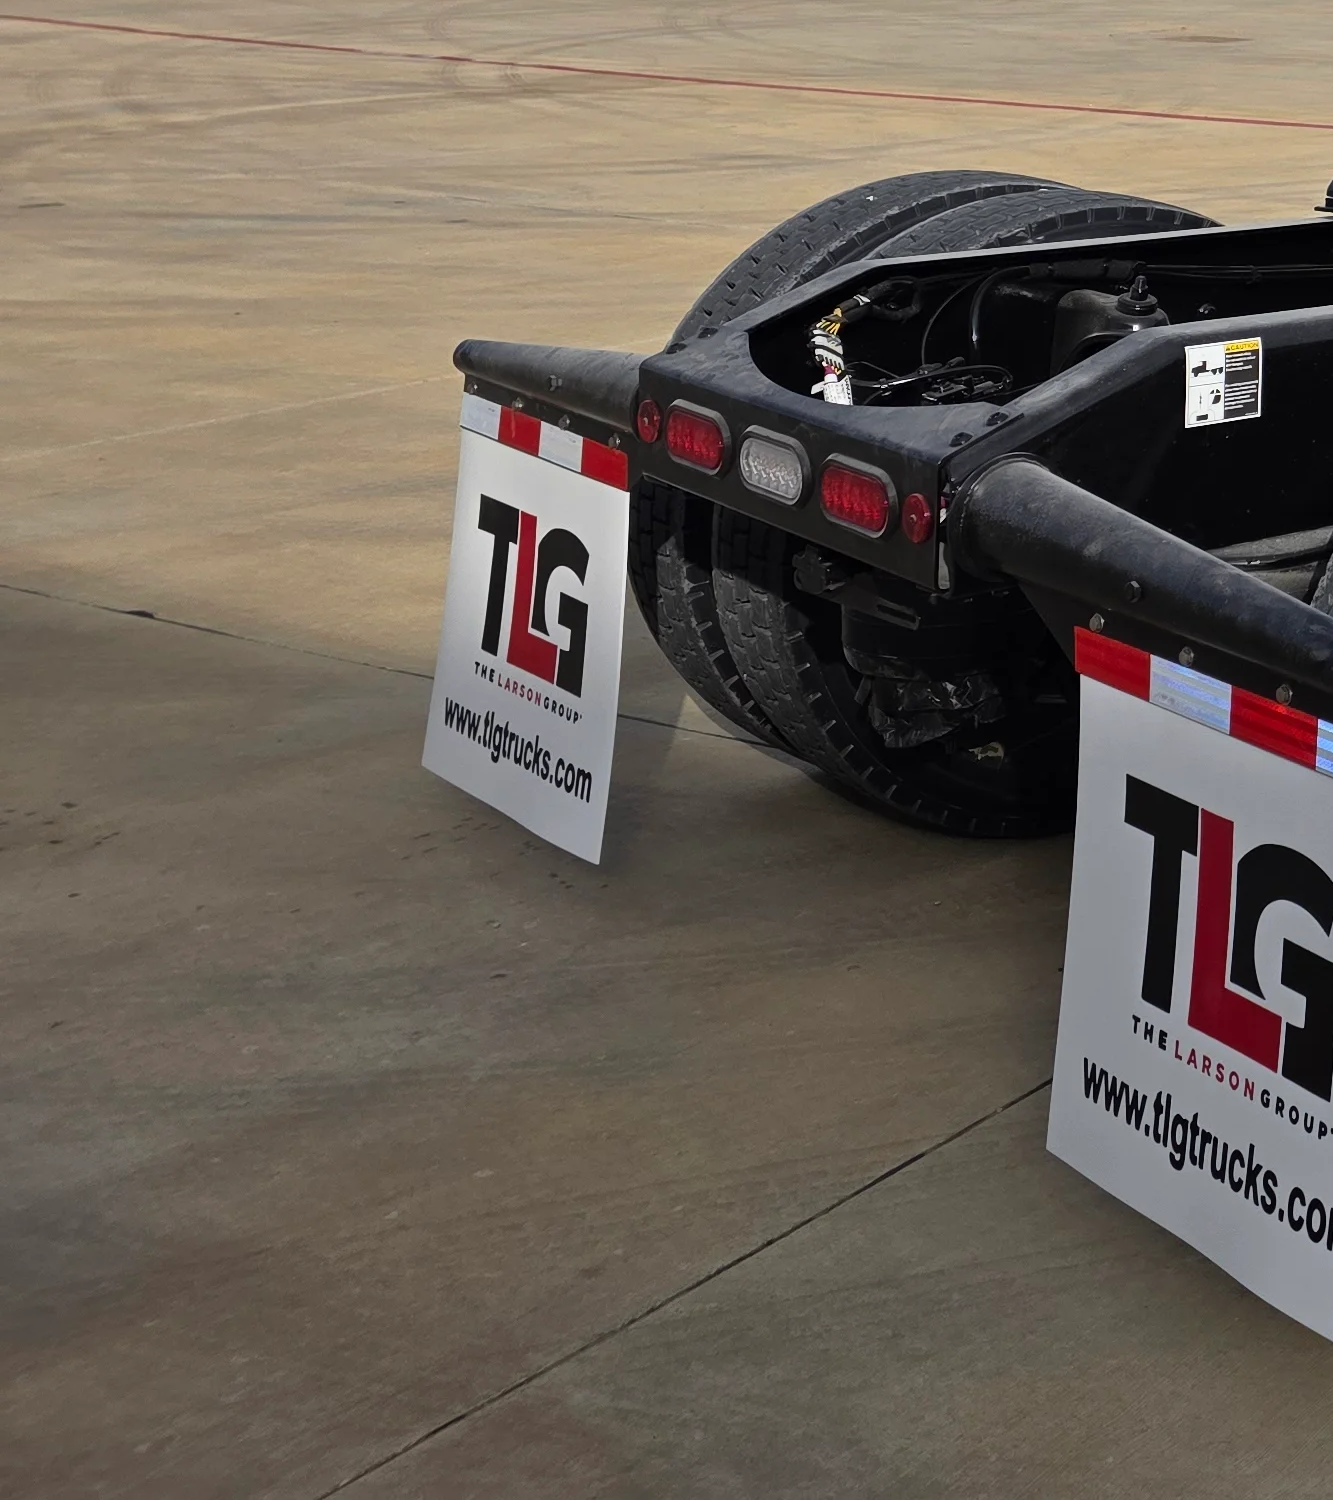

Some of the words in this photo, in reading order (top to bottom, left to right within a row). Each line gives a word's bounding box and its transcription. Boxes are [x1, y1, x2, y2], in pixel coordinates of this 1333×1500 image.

[477, 493, 590, 698] TLG
[444, 697, 592, 803] www.tlgtrucks.com
[474, 661, 496, 683] THE
[498, 673, 542, 706] LARSON
[543, 696, 579, 724] GROUP
[1132, 1014, 1168, 1051] THE
[1174, 1039, 1255, 1101] LARSON
[1260, 1088, 1328, 1140] GROUP
